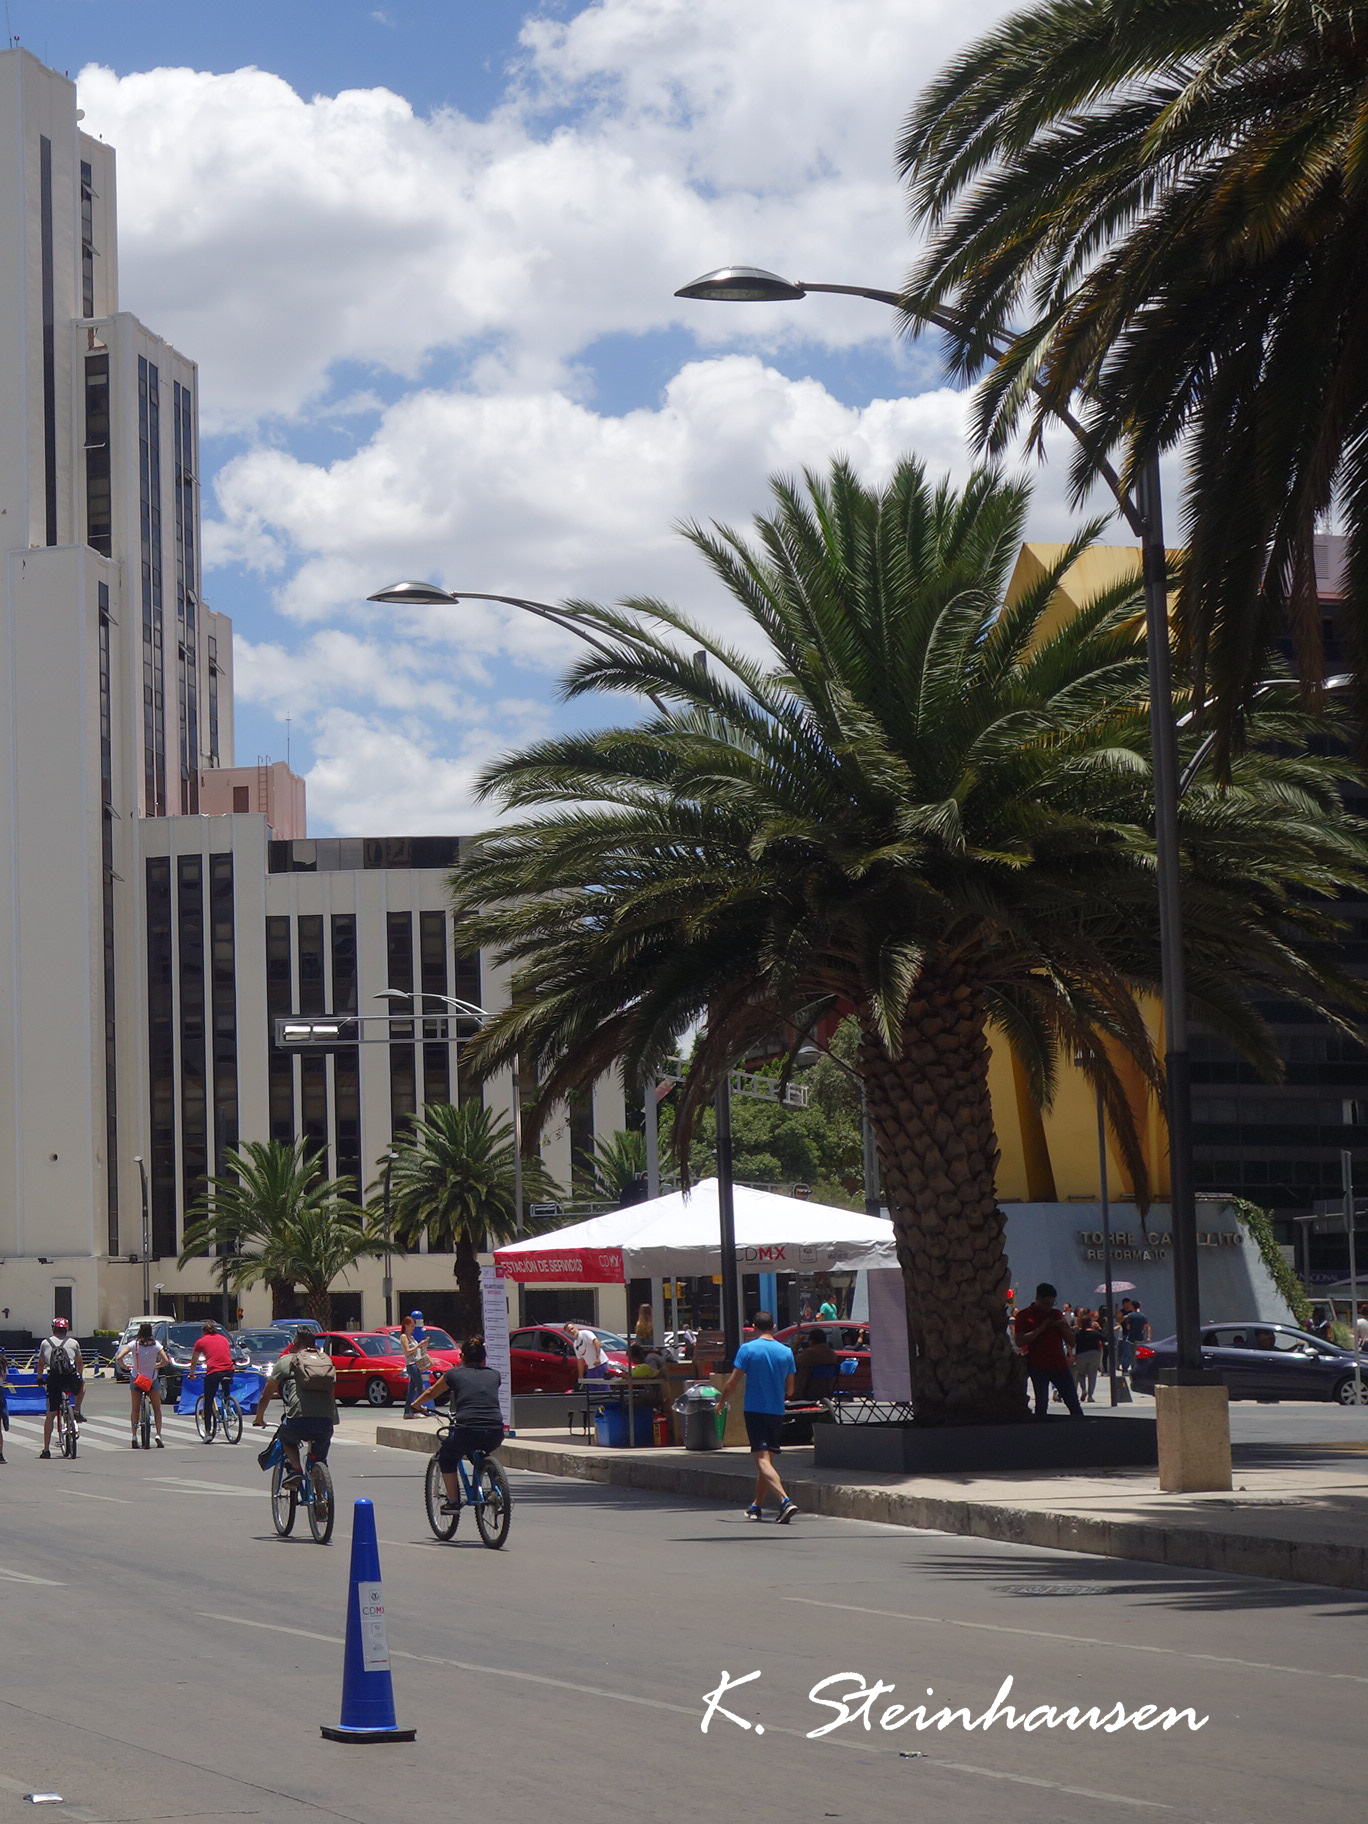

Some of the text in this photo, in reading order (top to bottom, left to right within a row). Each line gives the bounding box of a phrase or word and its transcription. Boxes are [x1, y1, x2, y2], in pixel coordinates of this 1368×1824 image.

[1147, 1231, 1244, 1247] CALLITO
[1087, 1249, 1151, 1261] REORMA
[550, 1258, 584, 1273] SERVICIOS
